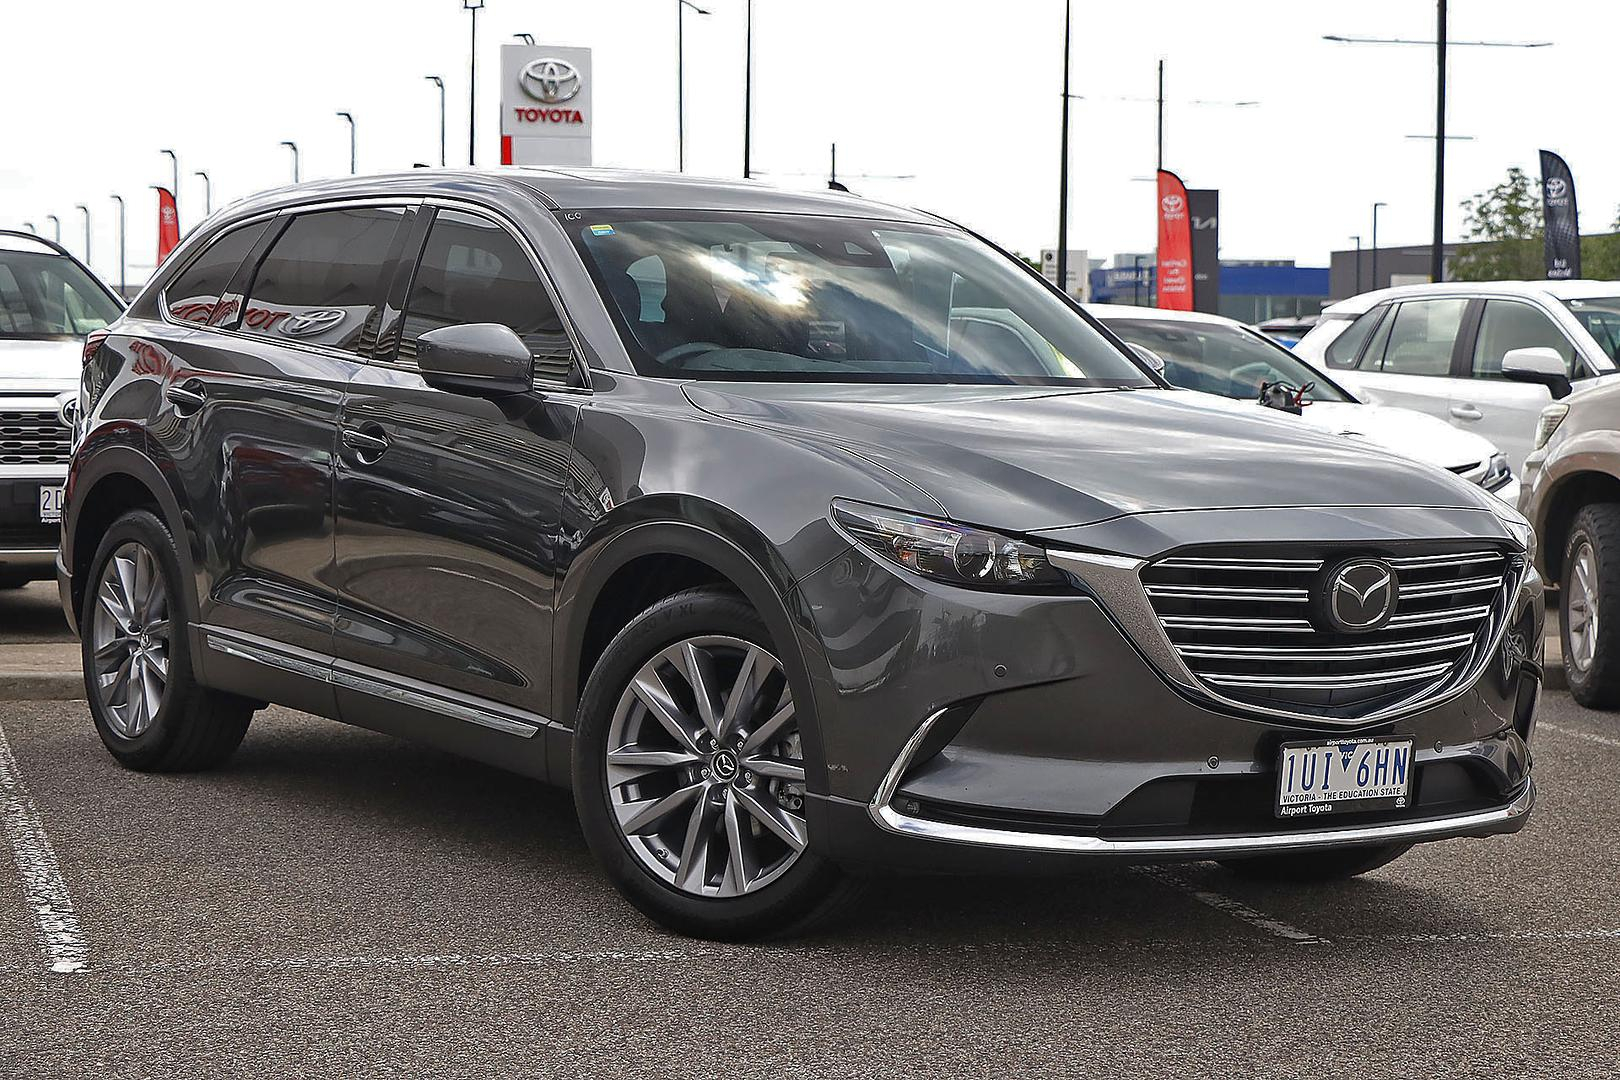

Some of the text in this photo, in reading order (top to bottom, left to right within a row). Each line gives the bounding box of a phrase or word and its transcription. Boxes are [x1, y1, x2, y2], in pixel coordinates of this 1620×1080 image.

[515, 108, 583, 123] TOYOTA
[1287, 747, 1408, 793] 1UI 6HN
[1282, 793, 1316, 803] VICTORIA
[1324, 792, 1337, 800] THE
[1339, 788, 1379, 799] EDUCATION
[1380, 787, 1401, 796] STATE
[1280, 803, 1333, 816] Airport Toyota
